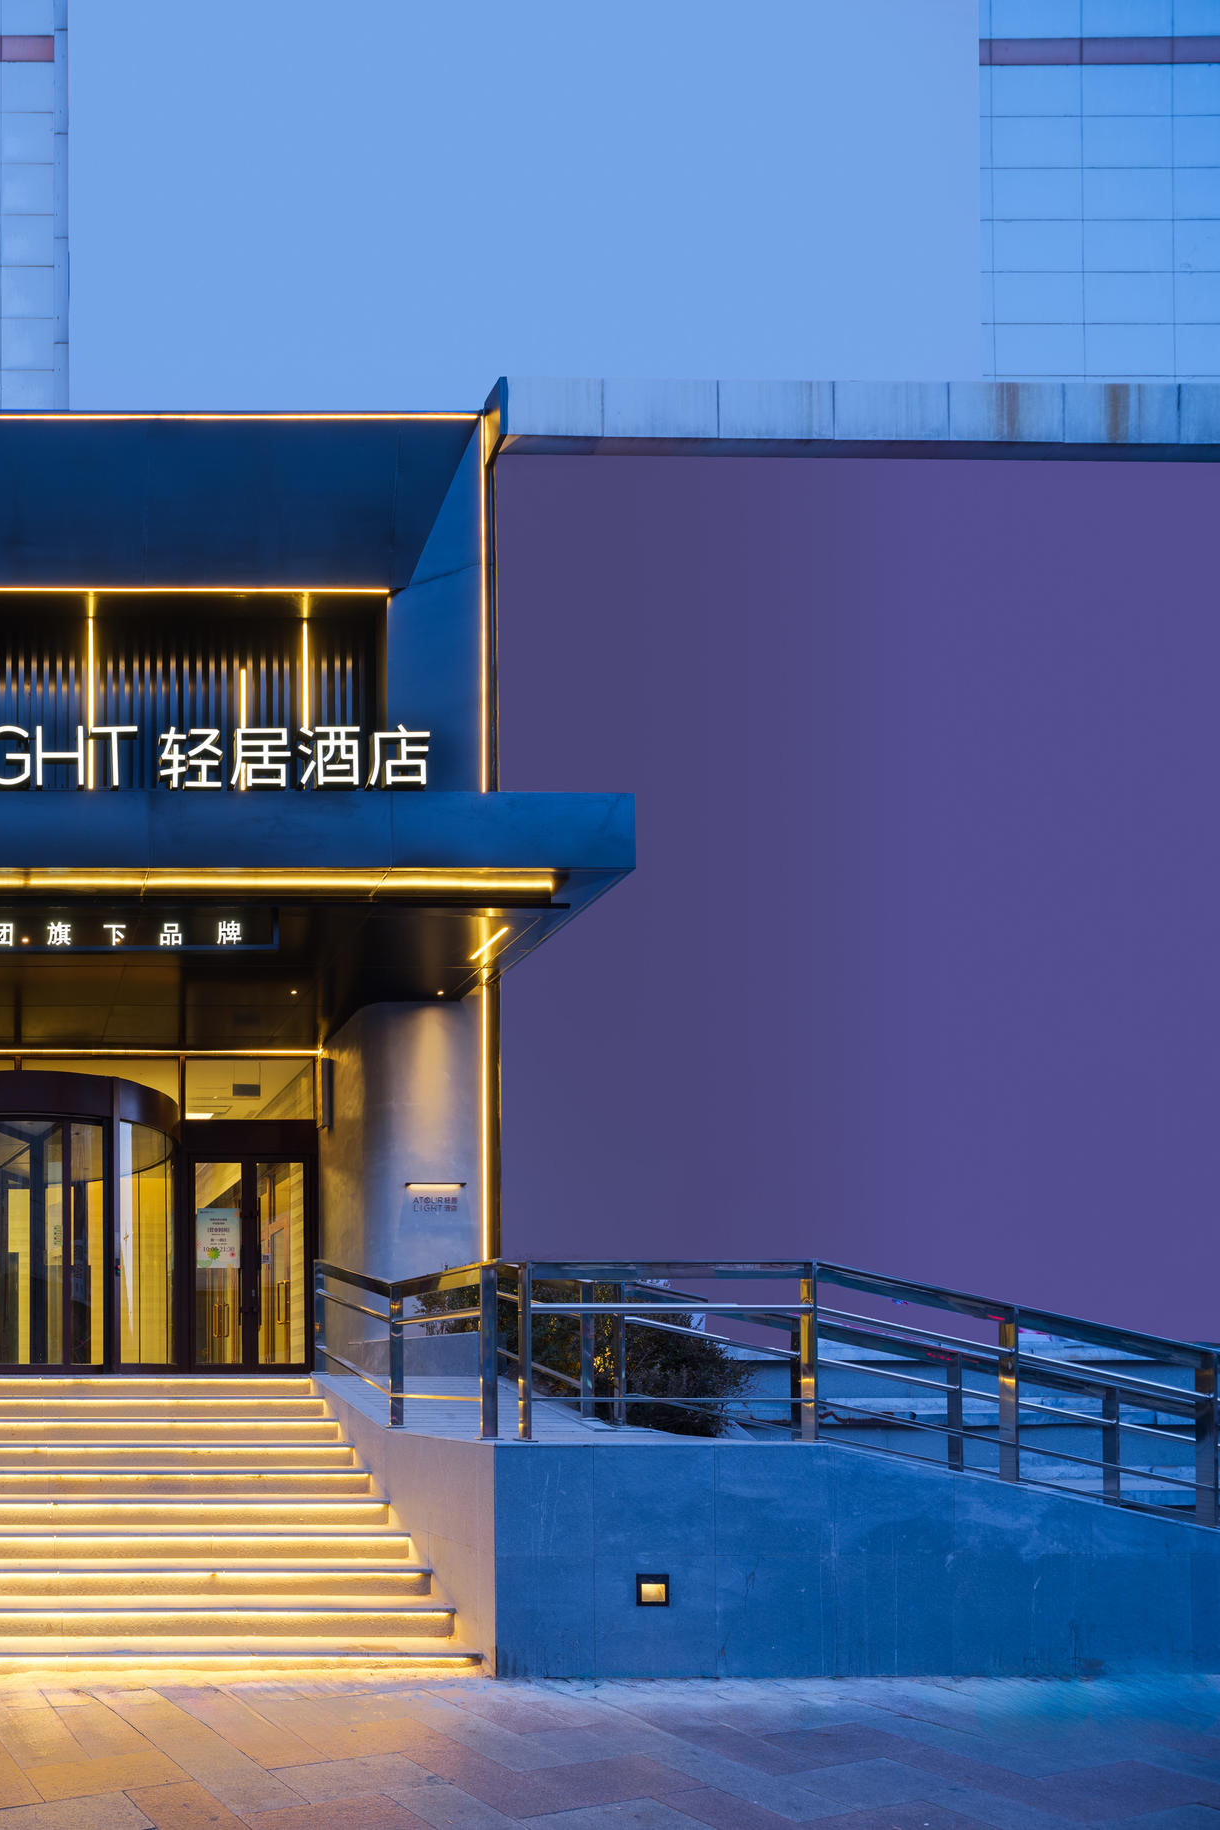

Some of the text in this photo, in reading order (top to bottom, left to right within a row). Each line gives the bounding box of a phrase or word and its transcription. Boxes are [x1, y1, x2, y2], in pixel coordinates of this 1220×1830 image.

[159, 724, 431, 788] 轻居酒店
[412, 1196, 443, 1204] ATOUR
[413, 1204, 442, 1212] LIGHT
